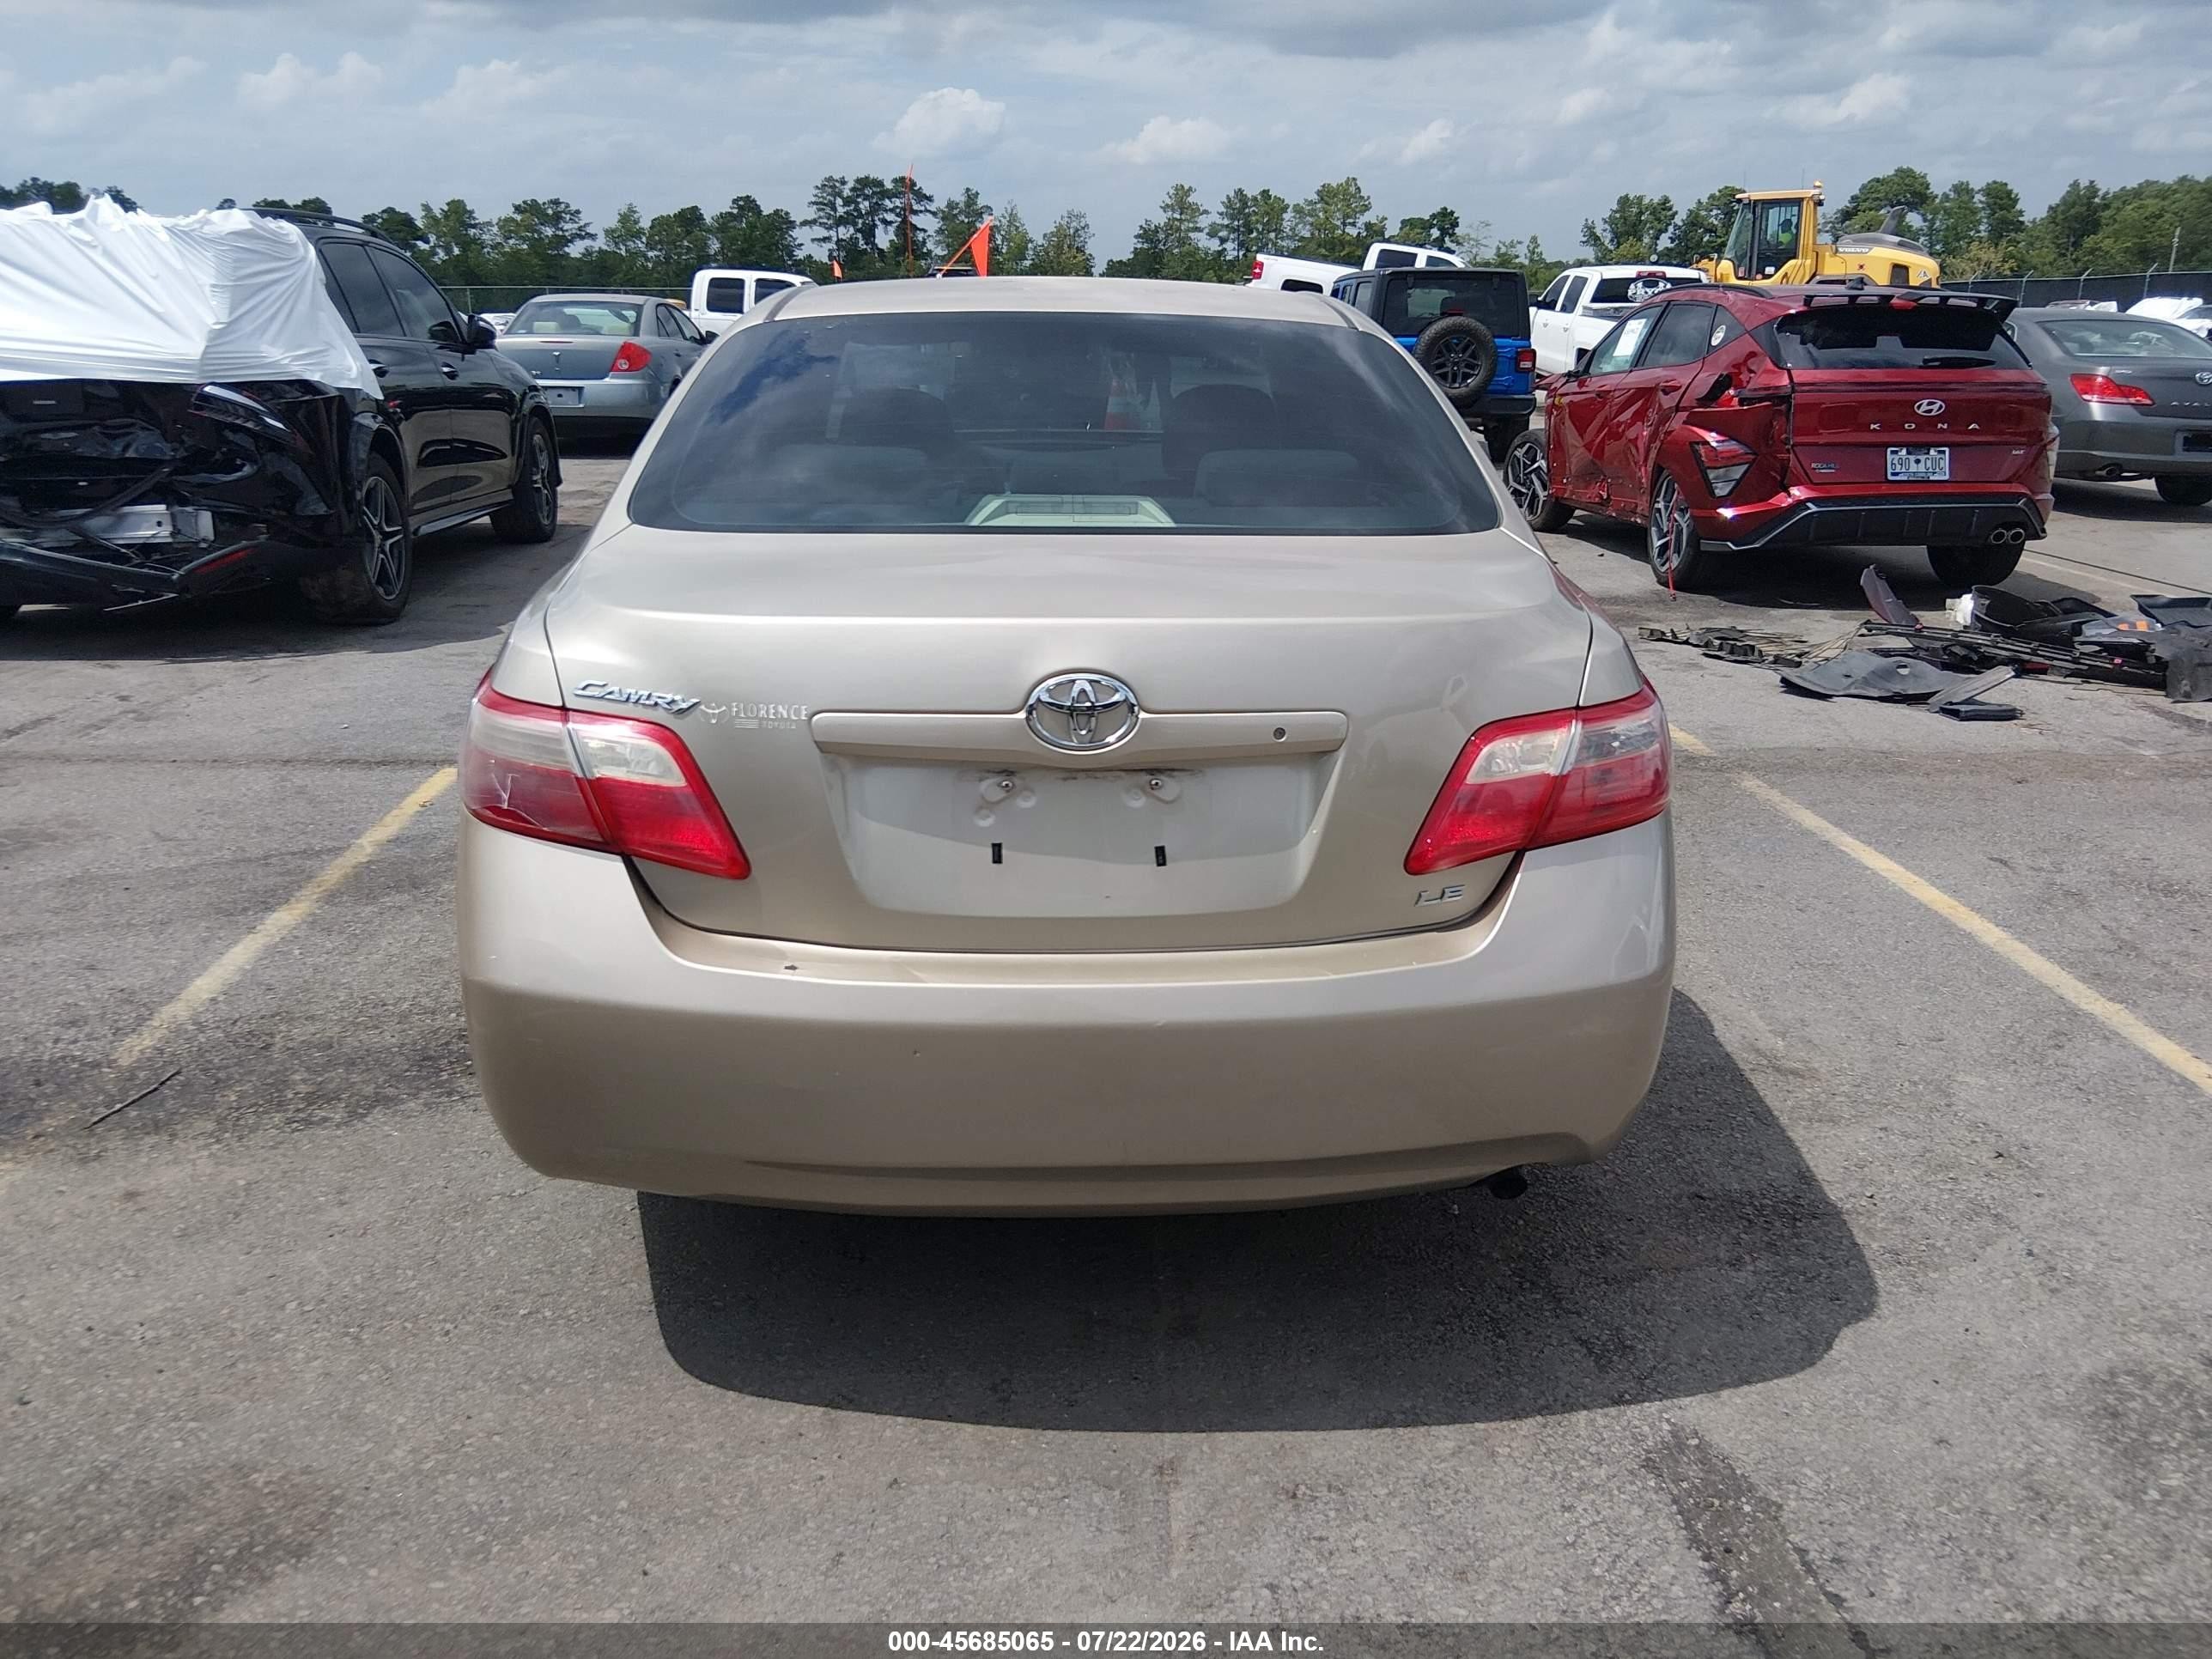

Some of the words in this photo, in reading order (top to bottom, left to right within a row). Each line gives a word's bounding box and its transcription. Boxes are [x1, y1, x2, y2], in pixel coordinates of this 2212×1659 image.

[1891, 457, 1911, 471] 690
[1924, 457, 1944, 471] CUC
[574, 679, 702, 714] CAMRY
[731, 702, 809, 720] FLORENCE
[1413, 884, 1465, 907] LE
